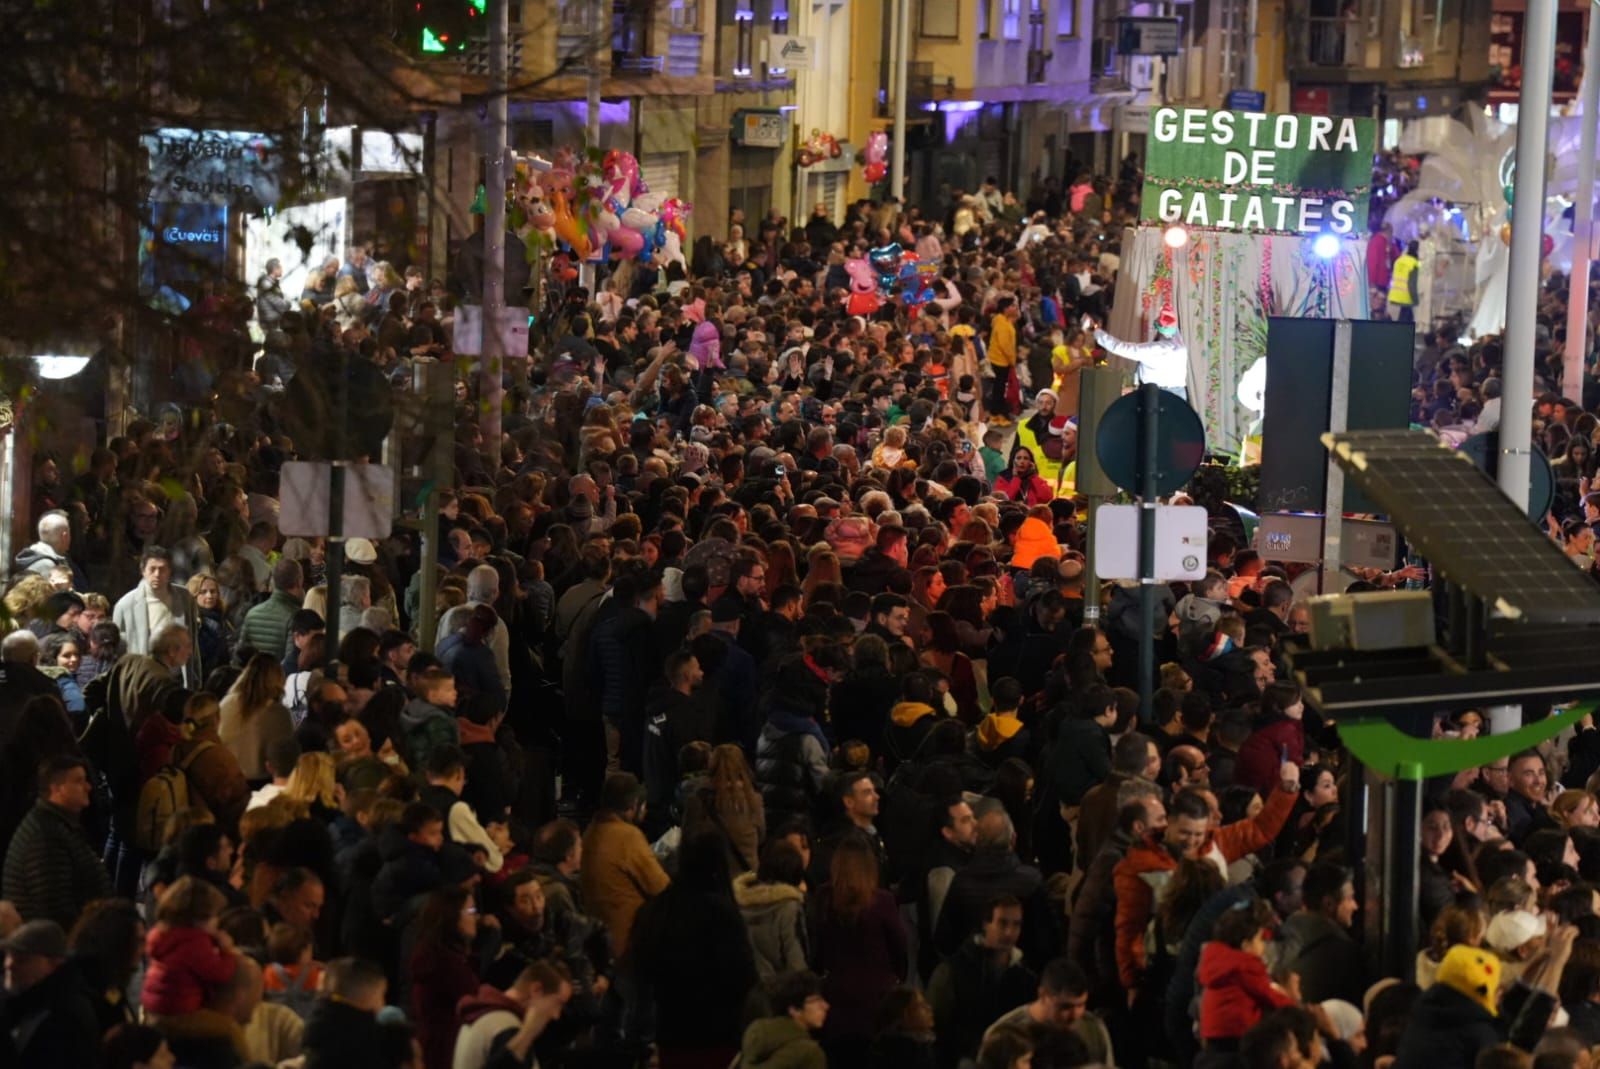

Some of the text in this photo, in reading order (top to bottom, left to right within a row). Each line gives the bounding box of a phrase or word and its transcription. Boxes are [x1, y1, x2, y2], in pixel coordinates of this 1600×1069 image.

[1154, 108, 1358, 152] GESTORA
[1223, 150, 1276, 185] DE
[1158, 189, 1355, 234] GAIATES
